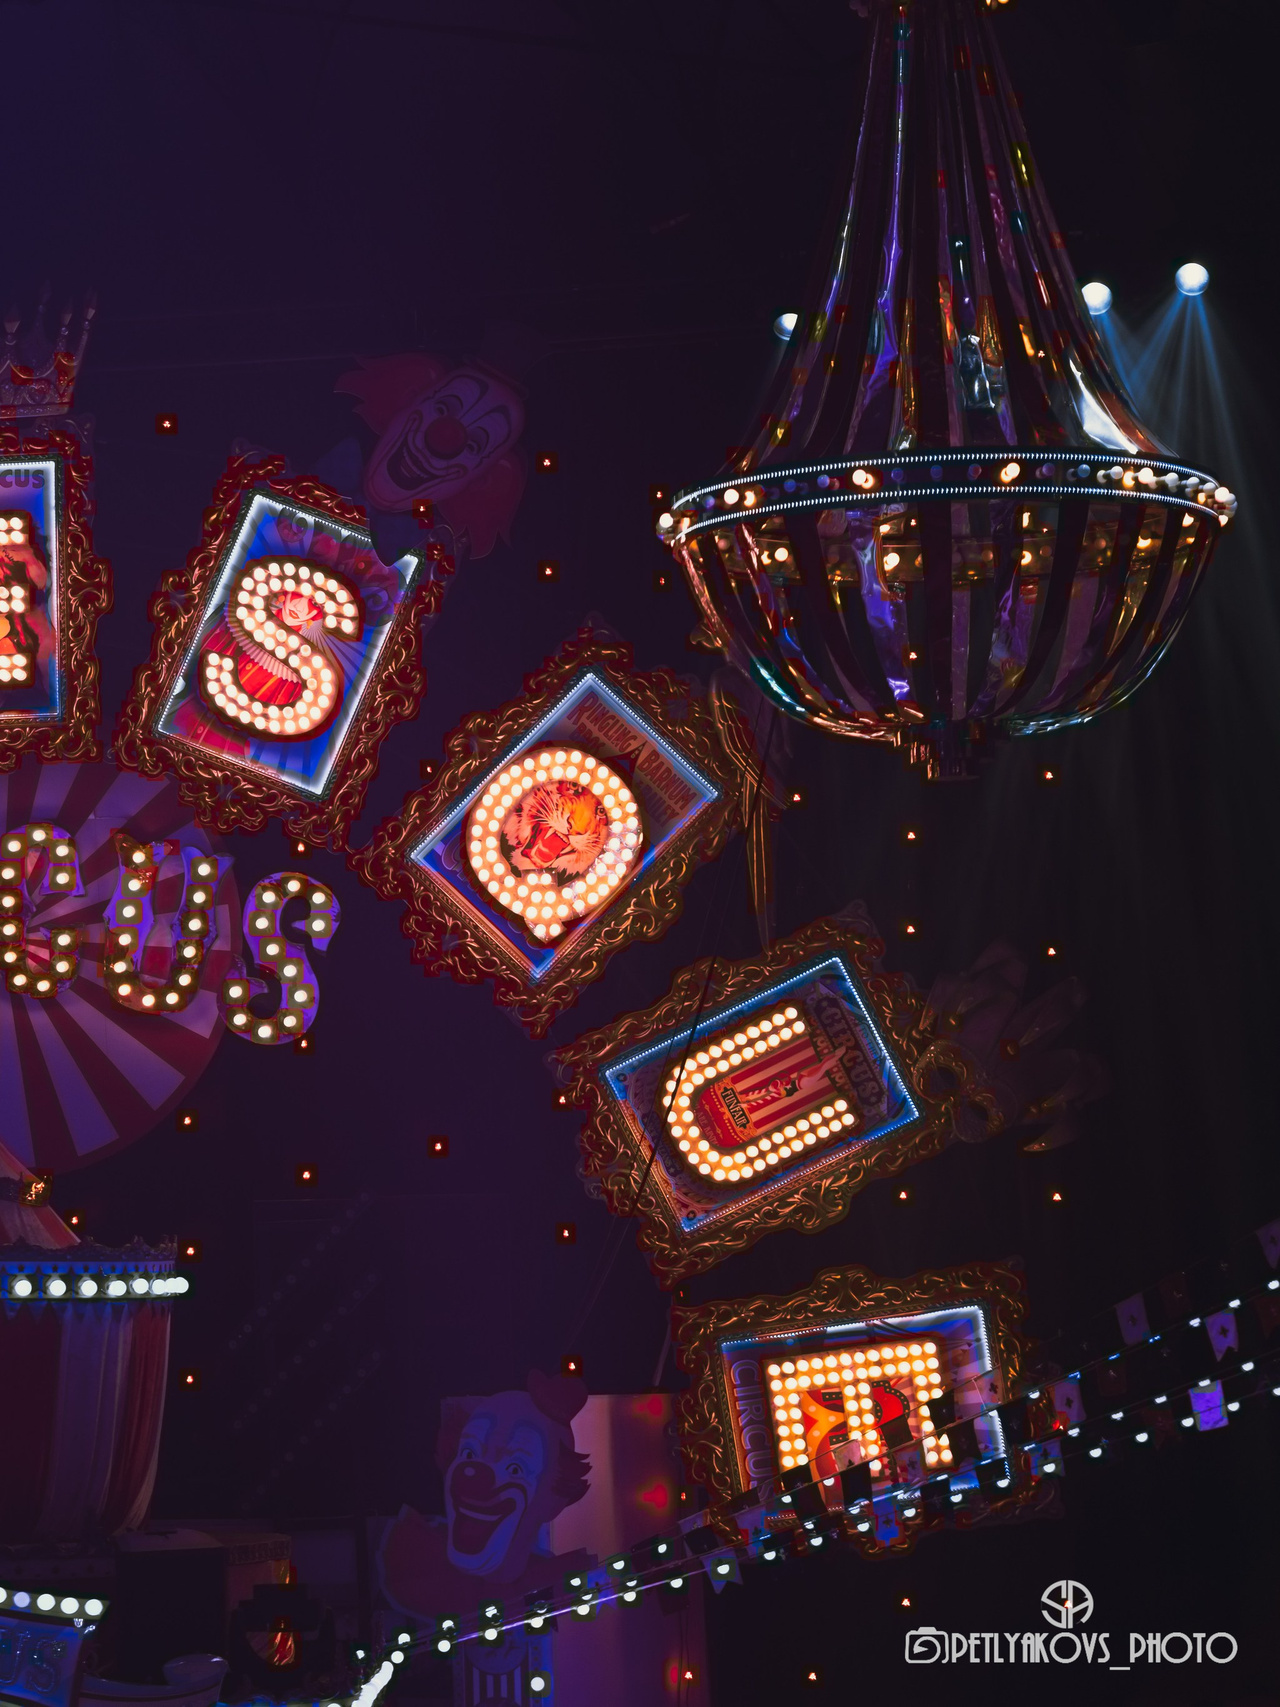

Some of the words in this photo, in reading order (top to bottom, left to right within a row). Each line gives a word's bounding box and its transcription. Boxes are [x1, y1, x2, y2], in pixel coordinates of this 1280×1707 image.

[566, 690, 638, 753] RINGLING
[637, 749, 697, 811] BARNUM
[822, 1006, 879, 1099] CIRCUS
[722, 1088, 748, 1130] FUNFAIR
